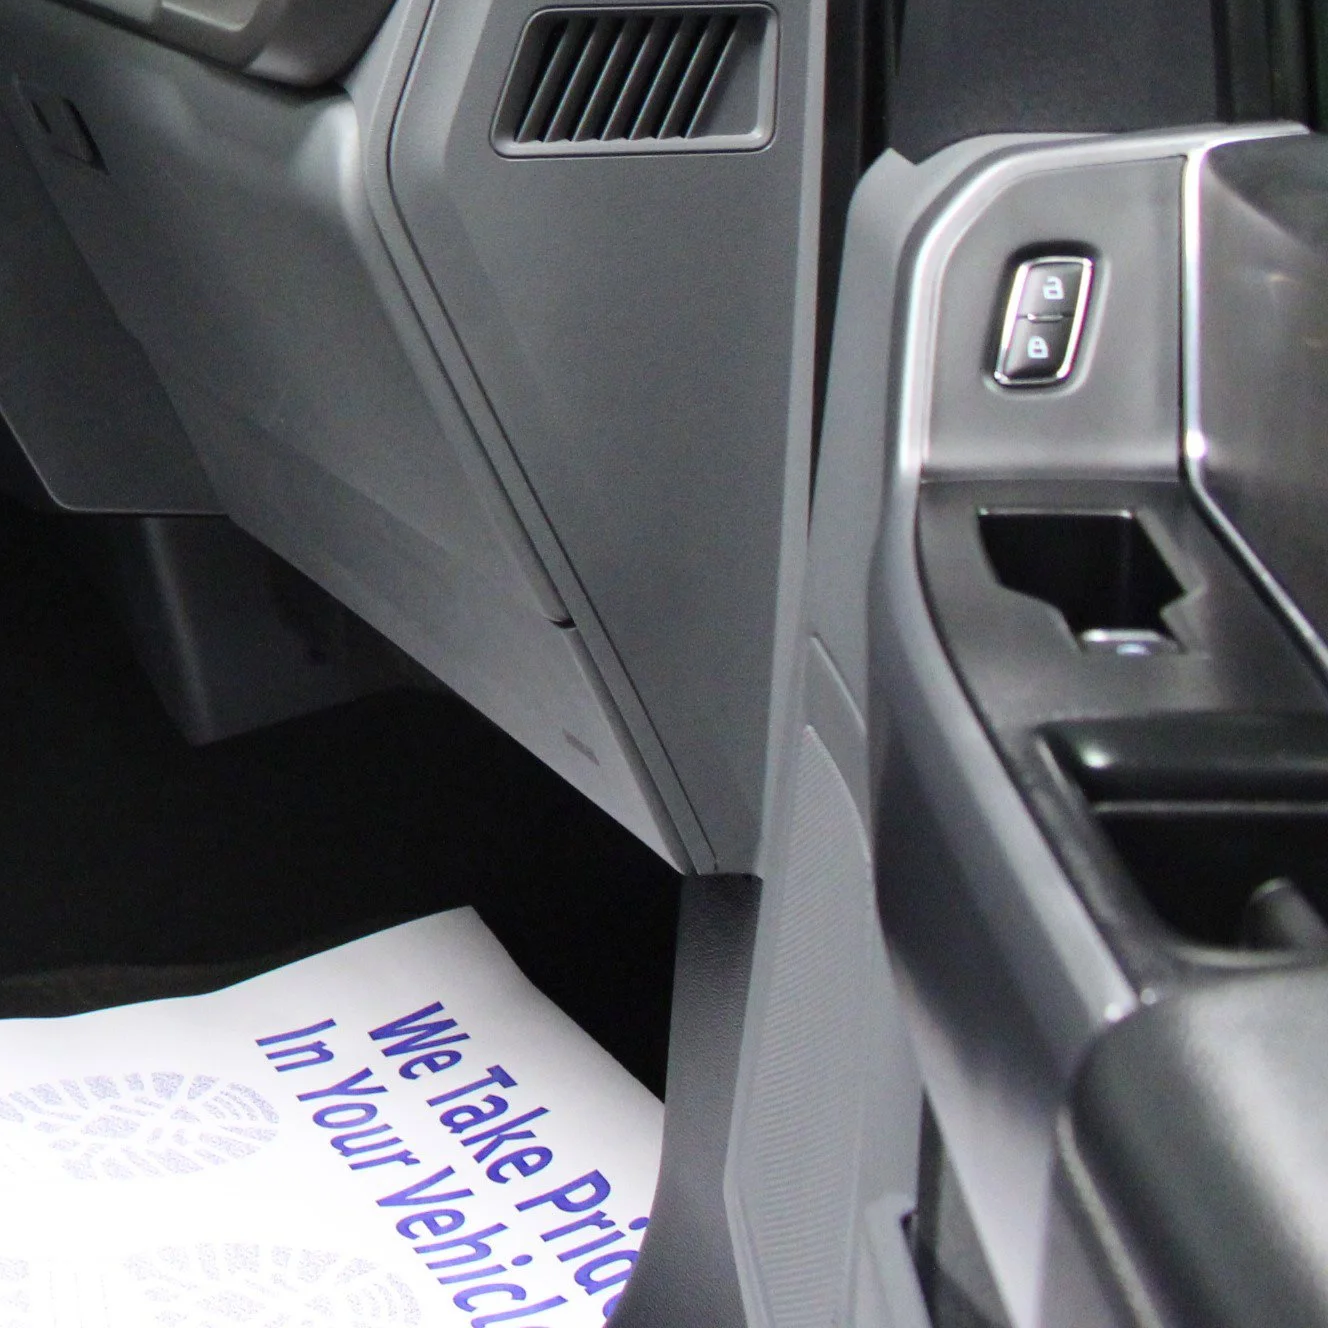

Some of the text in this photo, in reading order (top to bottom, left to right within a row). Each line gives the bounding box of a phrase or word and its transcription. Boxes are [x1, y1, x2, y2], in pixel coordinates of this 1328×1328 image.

[255, 1018, 568, 1328] In Your Vehicl
[367, 1001, 650, 1320] We Take Prid
